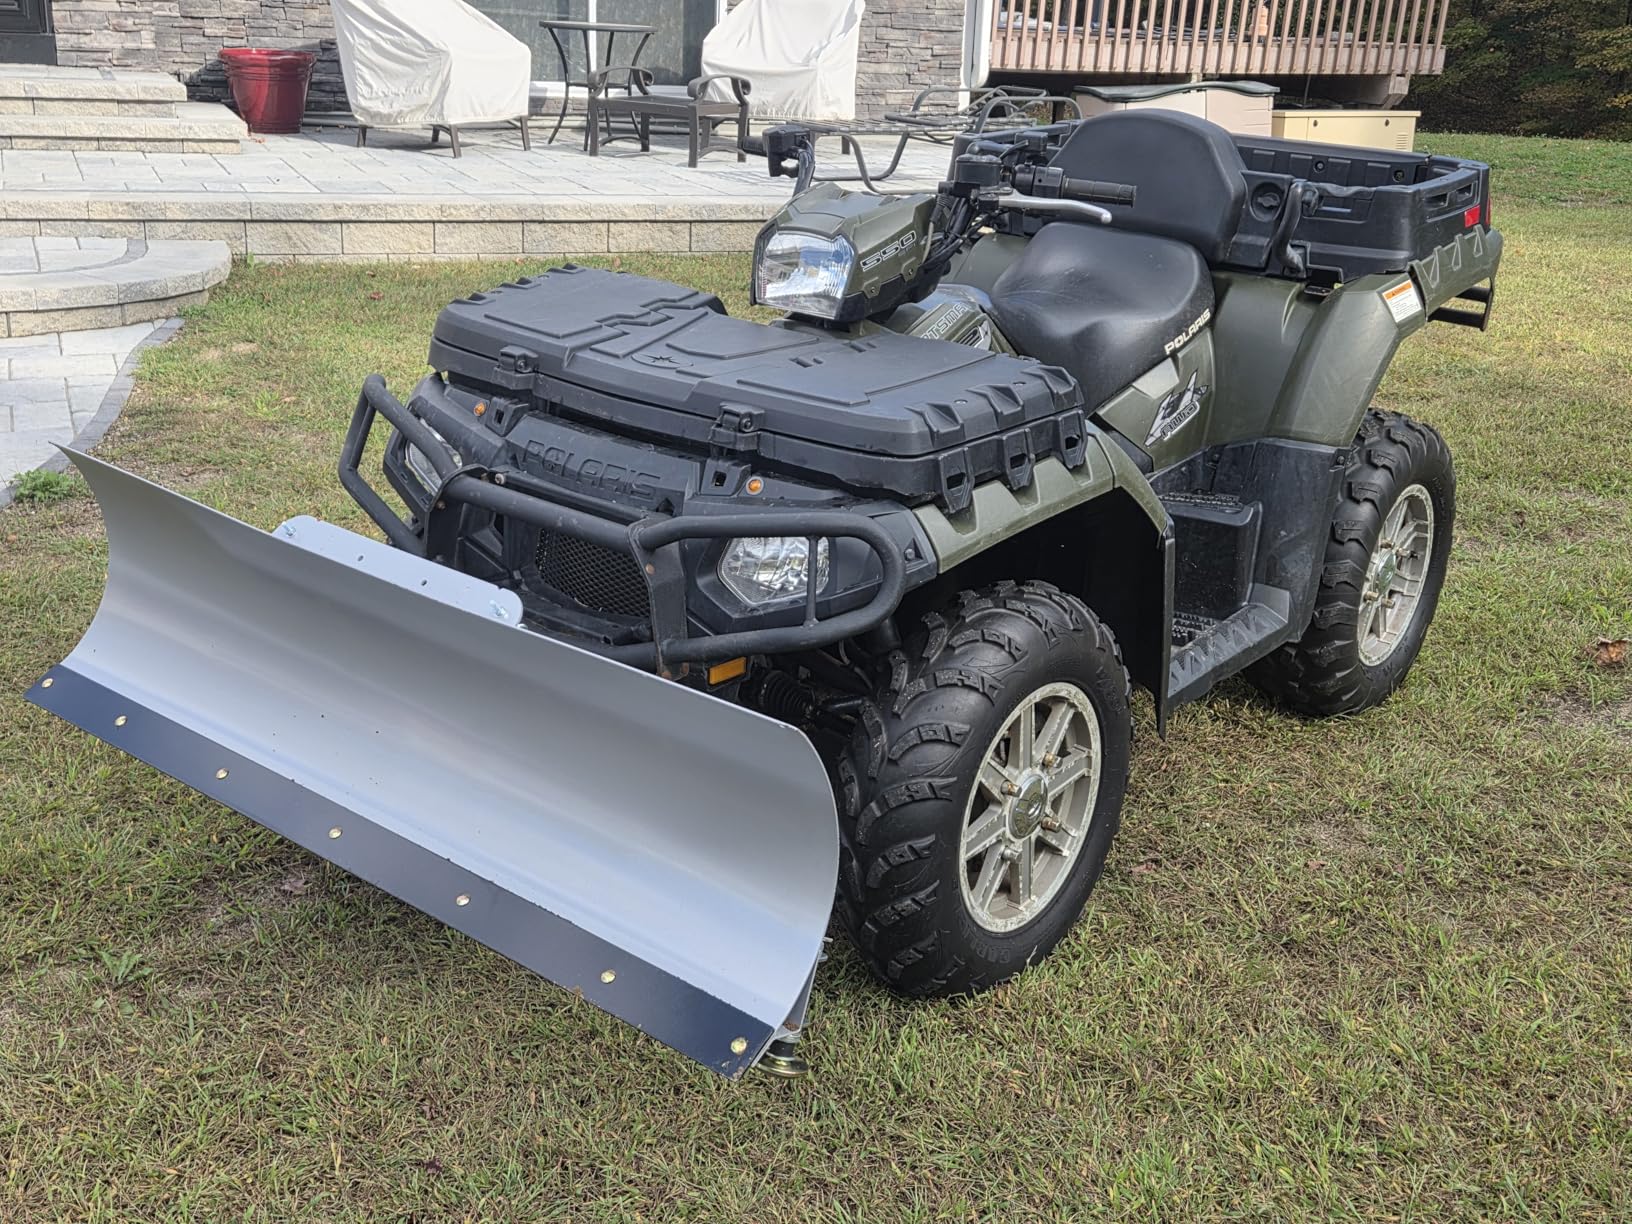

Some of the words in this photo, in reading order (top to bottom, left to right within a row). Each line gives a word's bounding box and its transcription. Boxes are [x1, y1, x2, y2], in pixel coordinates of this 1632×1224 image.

[860, 230, 916, 272] 550
[1164, 308, 1211, 355] POLARIS
[522, 439, 662, 499] POLARIS
